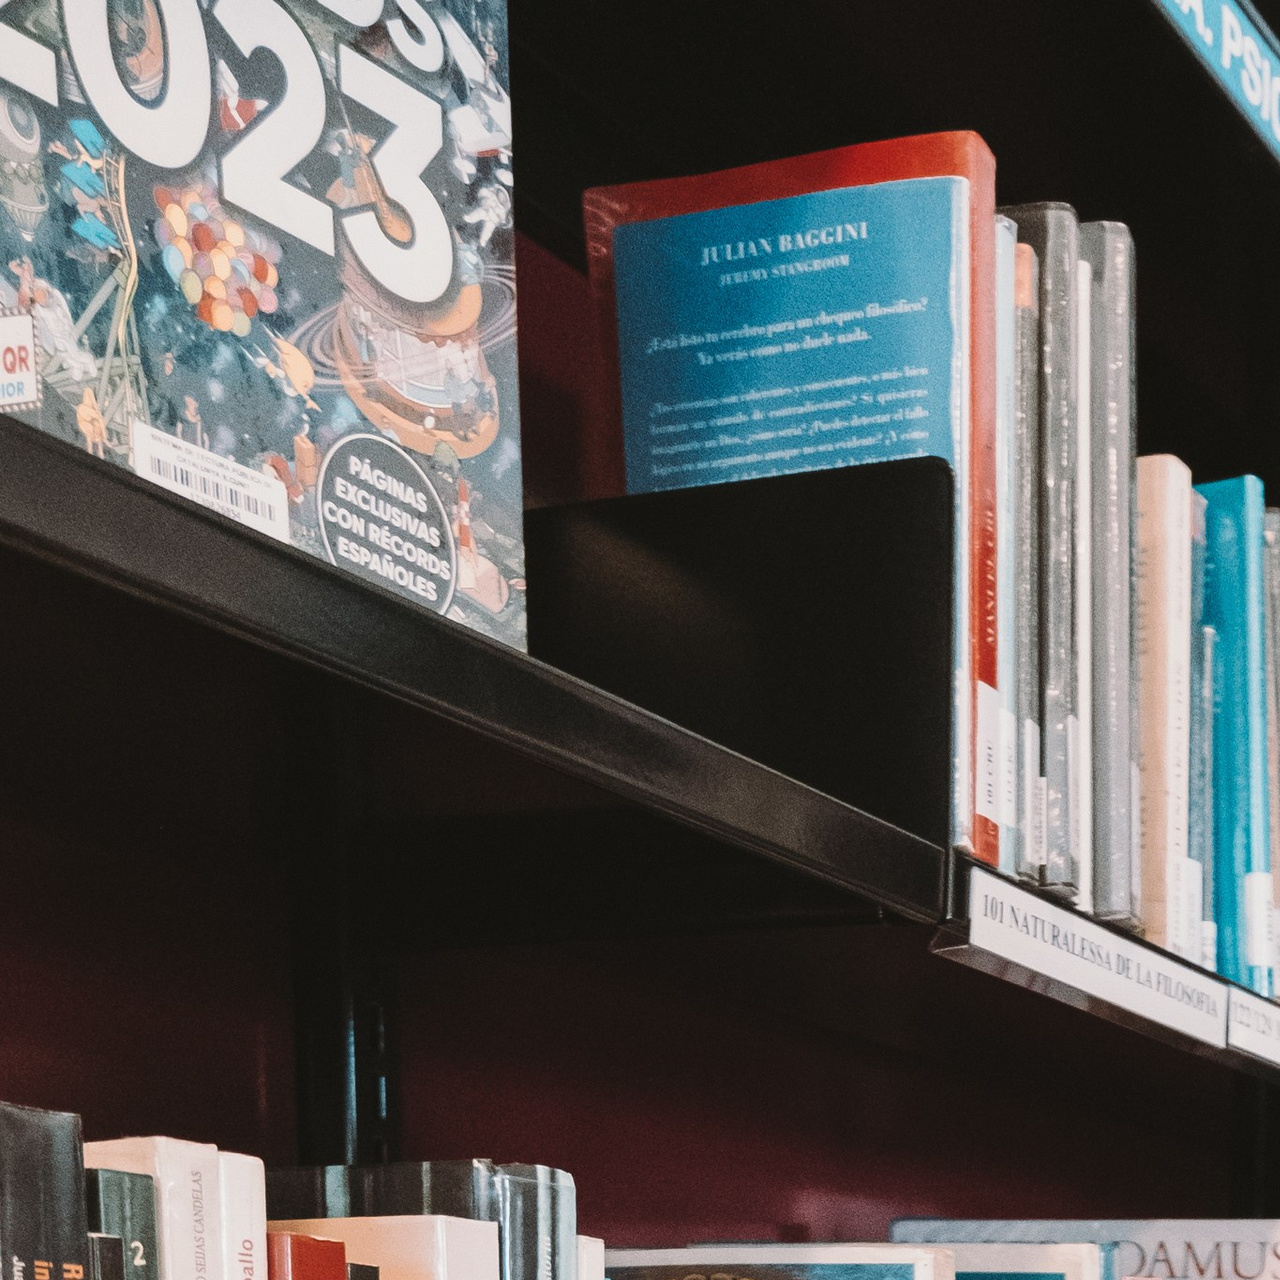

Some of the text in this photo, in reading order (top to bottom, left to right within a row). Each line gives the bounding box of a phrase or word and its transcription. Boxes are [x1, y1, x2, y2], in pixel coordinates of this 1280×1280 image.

[700, 221, 868, 267] JULIAN BAGGINI
[335, 476, 441, 548] EXCLUSIVAS
[348, 455, 428, 513] PÁGINAS
[322, 500, 452, 581] CON RÉCORDS
[337, 536, 439, 602] ESPAÑOLES
[983, 893, 1005, 924] 101
[1008, 904, 1113, 970] NATURALESSA
[1115, 953, 1134, 981] DE
[1135, 961, 1154, 989] LA
[191, 1170, 206, 1235] CANDELAS
[130, 1240, 147, 1266] 2
